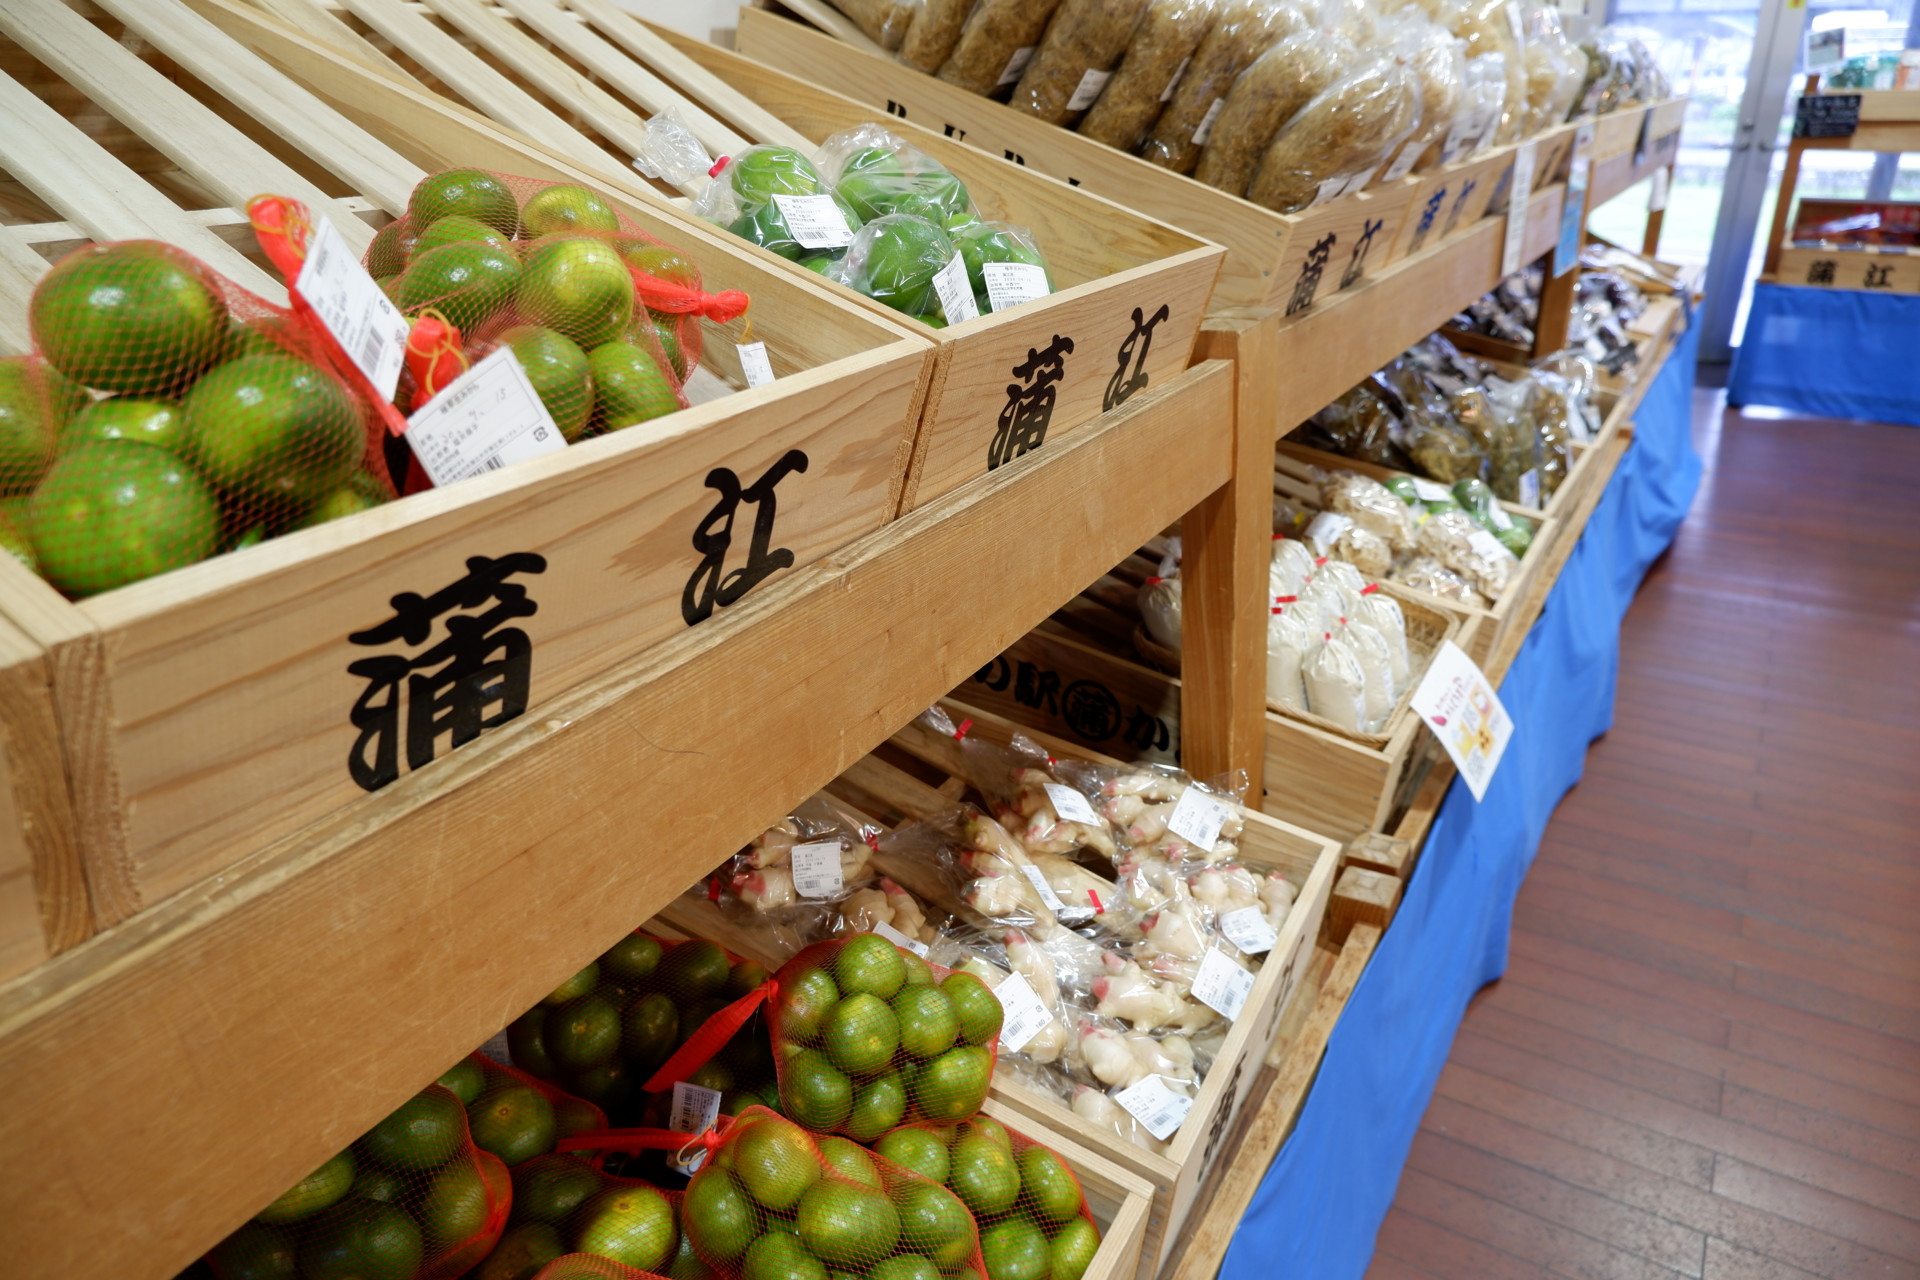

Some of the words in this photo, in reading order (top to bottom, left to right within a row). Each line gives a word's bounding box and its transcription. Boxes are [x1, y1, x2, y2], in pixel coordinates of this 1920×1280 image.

[1285, 218, 1383, 317] 蒲江
[1807, 259, 1896, 288] 蒲江
[988, 304, 1169, 471] 蒲江
[347, 448, 809, 792] 蒲江
[974, 654, 1181, 762] の駅蒲か
